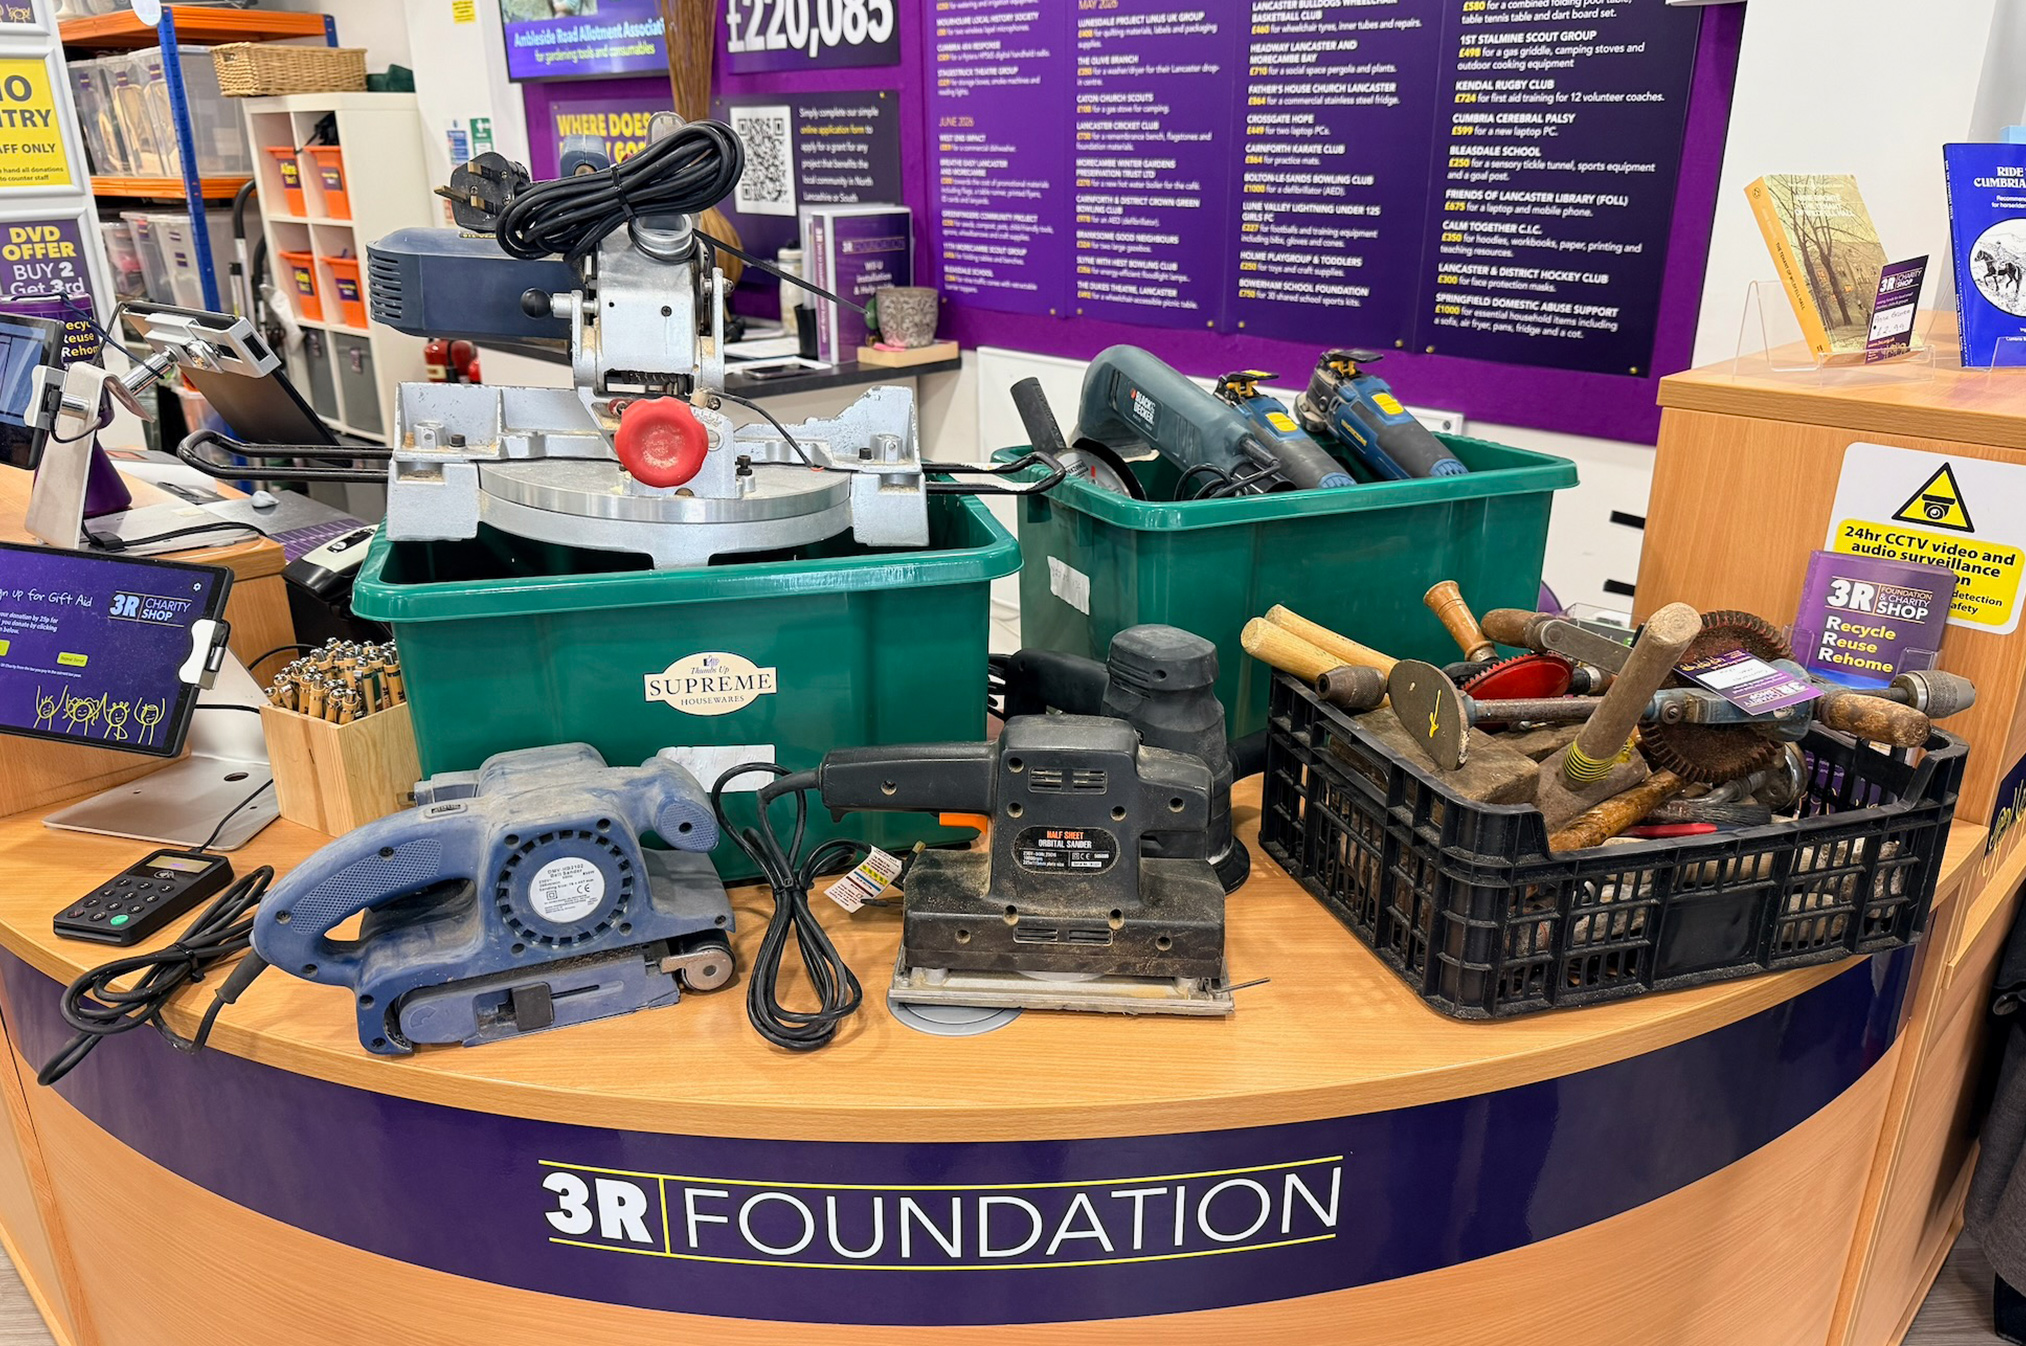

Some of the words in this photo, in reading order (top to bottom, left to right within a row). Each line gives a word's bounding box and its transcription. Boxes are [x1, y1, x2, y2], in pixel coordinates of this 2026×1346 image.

[514, 29, 556, 47] Ambleside
[557, 26, 578, 44] Road
[579, 23, 622, 42] Allotment
[726, 0, 893, 58] £220,085
[1460, 34, 1477, 45] 1ST
[1478, 33, 1524, 44] STALMINE
[1526, 31, 1559, 43] SCOUT
[1561, 30, 1597, 42] GROUP
[535, 50, 543, 62] for
[545, 48, 577, 65] gardening
[578, 45, 594, 60] tools
[595, 44, 608, 58] and
[609, 40, 655, 56] consumables
[0, 75, 32, 102] O
[1456, 81, 1493, 91] KENDAL
[1495, 80, 1527, 90] RUGBY
[1529, 79, 1554, 89] CLUB
[1455, 94, 1476, 103] £724
[1478, 94, 1490, 102] for
[1491, 93, 1507, 103] first
[1508, 93, 1521, 102] aid
[1523, 93, 1554, 105] training
[1556, 92, 1568, 102] for
[1571, 93, 1581, 101] 12
[1583, 92, 1623, 102] volunteer
[1626, 92, 1664, 101] coaches.
[0, 109, 51, 127] TRY
[799, 107, 818, 119] Simply
[819, 107, 846, 119] complete
[858, 106, 879, 118] simple
[1247, 114, 1290, 124] CROSSGATE
[1292, 114, 1314, 124] HOPE
[1453, 113, 1494, 123] CUMBRIA
[1497, 113, 1543, 123] CEREBRAL
[1545, 113, 1575, 123] PALSY
[556, 113, 607, 137] WHERE
[800, 125, 818, 134] online
[819, 125, 849, 136] application
[850, 124, 864, 134] form
[865, 125, 873, 134] to
[1076, 121, 1112, 130] LANCASTER
[1114, 121, 1140, 130] CRICKET
[1141, 121, 1159, 130] CLUB
[1452, 126, 1473, 136] £599
[1474, 126, 1486, 135] for
[1514, 126, 1541, 138] laptop
[1543, 127, 1558, 136] PC.
[22, 143, 55, 153] ONLY
[1450, 146, 1501, 156] BLEASDALE
[1502, 147, 1541, 156] SCHOOL
[1997, 166, 2024, 177] RIDE
[1974, 177, 2026, 188] CUMBRIA
[1446, 190, 1483, 201] FRIENDS
[1485, 190, 1498, 201] OF
[1499, 191, 1553, 203] LANCASTER
[1556, 193, 1596, 204] LIBRARY
[1597, 195, 1628, 207] (FOLL)
[9, 226, 61, 243] DVD
[1443, 221, 1468, 231] CALM
[1469, 222, 1517, 233] TOGETHER
[1518, 224, 1542, 234] C.I.C.
[2, 242, 77, 261] OFFER
[1780, 252, 1789, 269] TENANT
[13, 263, 54, 280] BUY
[59, 261, 74, 277] 2
[1439, 263, 1488, 275] LANCASTER
[1499, 266, 1539, 279] DISTRICT
[1541, 270, 1581, 282] HOCKEY
[1582, 272, 1609, 284] CLUB
[10, 282, 45, 294] Get
[50, 277, 85, 294] 3rd
[1239, 279, 1282, 290] BOWERHAM
[1284, 282, 1313, 293] SCHOOL
[1315, 284, 1369, 296] FOUNDATION
[1880, 277, 1895, 292] 3R
[1898, 269, 1922, 280] CHARITY
[1897, 279, 1913, 288] SHOP
[1436, 293, 1490, 306] SPRINGFIELD
[1492, 296, 1539, 310] DOMESTIC
[1541, 299, 1572, 313] ABUSE
[1574, 302, 1618, 317] SUPPORT
[61, 345, 99, 357] Rehom
[1844, 526, 1882, 542] 24hr
[1885, 533, 1928, 550] CCTV
[1932, 542, 1978, 559] video
[1982, 550, 2016, 566] and
[1852, 541, 1896, 558] audio
[1900, 552, 2001, 577] surveillance
[12, 589, 23, 601] up
[28, 588, 45, 601] for
[48, 592, 73, 605] Gift
[75, 594, 93, 607] Aid
[1826, 579, 1875, 612] 3R
[1881, 586, 1933, 600] FOUNDATION
[1879, 593, 1886, 601] &
[1888, 594, 1930, 607] CHARITY
[1952, 590, 2003, 607] detection
[109, 594, 140, 618] 3R
[145, 598, 191, 613] CHARITY
[1876, 602, 1929, 620] SHOP
[1950, 602, 1978, 615] afety
[9, 612, 32, 620] donation
[141, 610, 173, 622] SHOP
[12, 620, 29, 628] donate
[37, 624, 58, 632] clicking
[1826, 615, 1896, 641] Recycle
[1822, 631, 1878, 653] Reuse
[1818, 647, 1893, 673] Rehome
[691, 667, 716, 675] Thumbs
[718, 665, 730, 674] Up
[650, 673, 772, 696] SUPREME
[681, 695, 745, 706] HOUSEWARES
[1047, 831, 1062, 839] HALF
[1064, 831, 1084, 839] SHEET
[1038, 839, 1065, 848] ORBITAL
[1066, 840, 1092, 849] SANDER
[542, 1171, 656, 1245] 3R
[685, 1167, 1342, 1259] FOUNDATION
